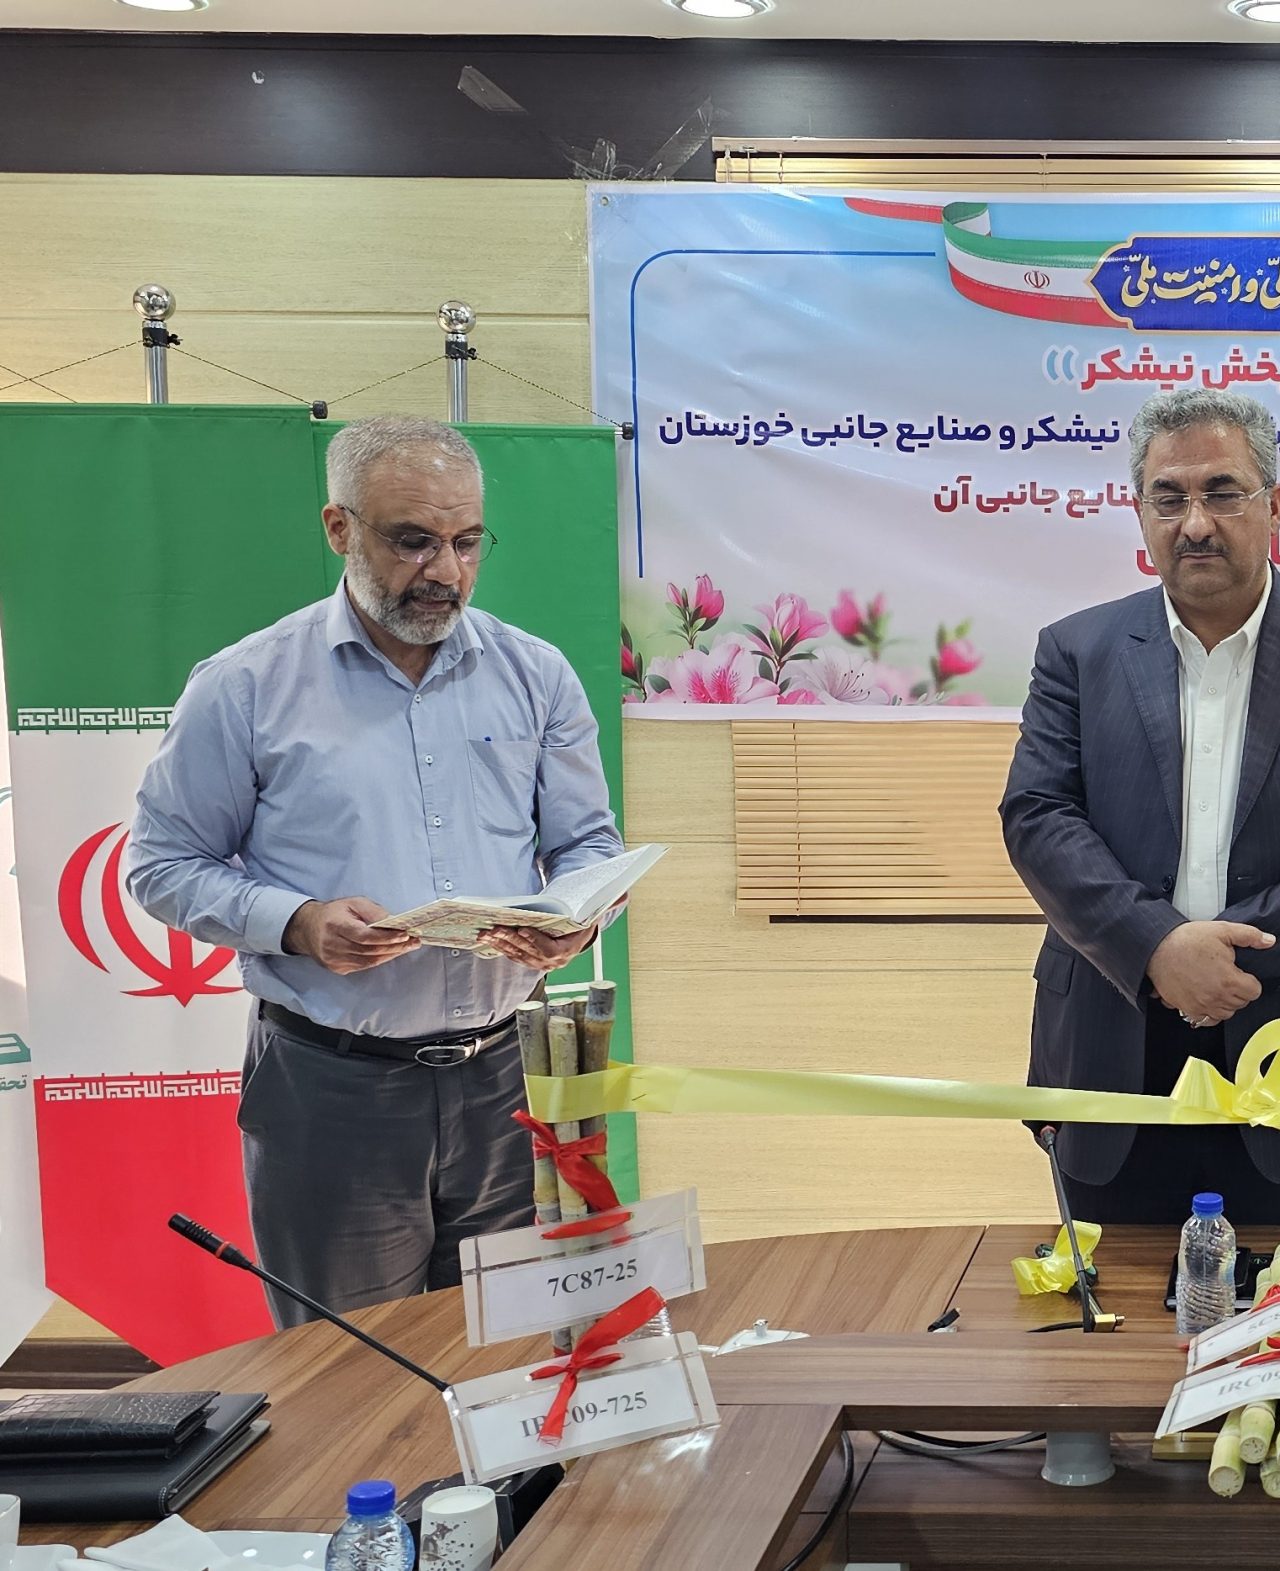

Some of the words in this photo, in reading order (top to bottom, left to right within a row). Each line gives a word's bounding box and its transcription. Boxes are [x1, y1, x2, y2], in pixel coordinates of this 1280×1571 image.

[659, 411, 794, 446] خوزستان
[800, 413, 889, 448] جانبی
[896, 414, 992, 453] صنایع
[998, 424, 1017, 450] و
[1021, 413, 1121, 451] نیشکر
[933, 475, 973, 513] آن
[975, 481, 1060, 514] جانبی
[1066, 482, 1138, 518] نایع
[547, 1257, 639, 1298] 7C87-25
